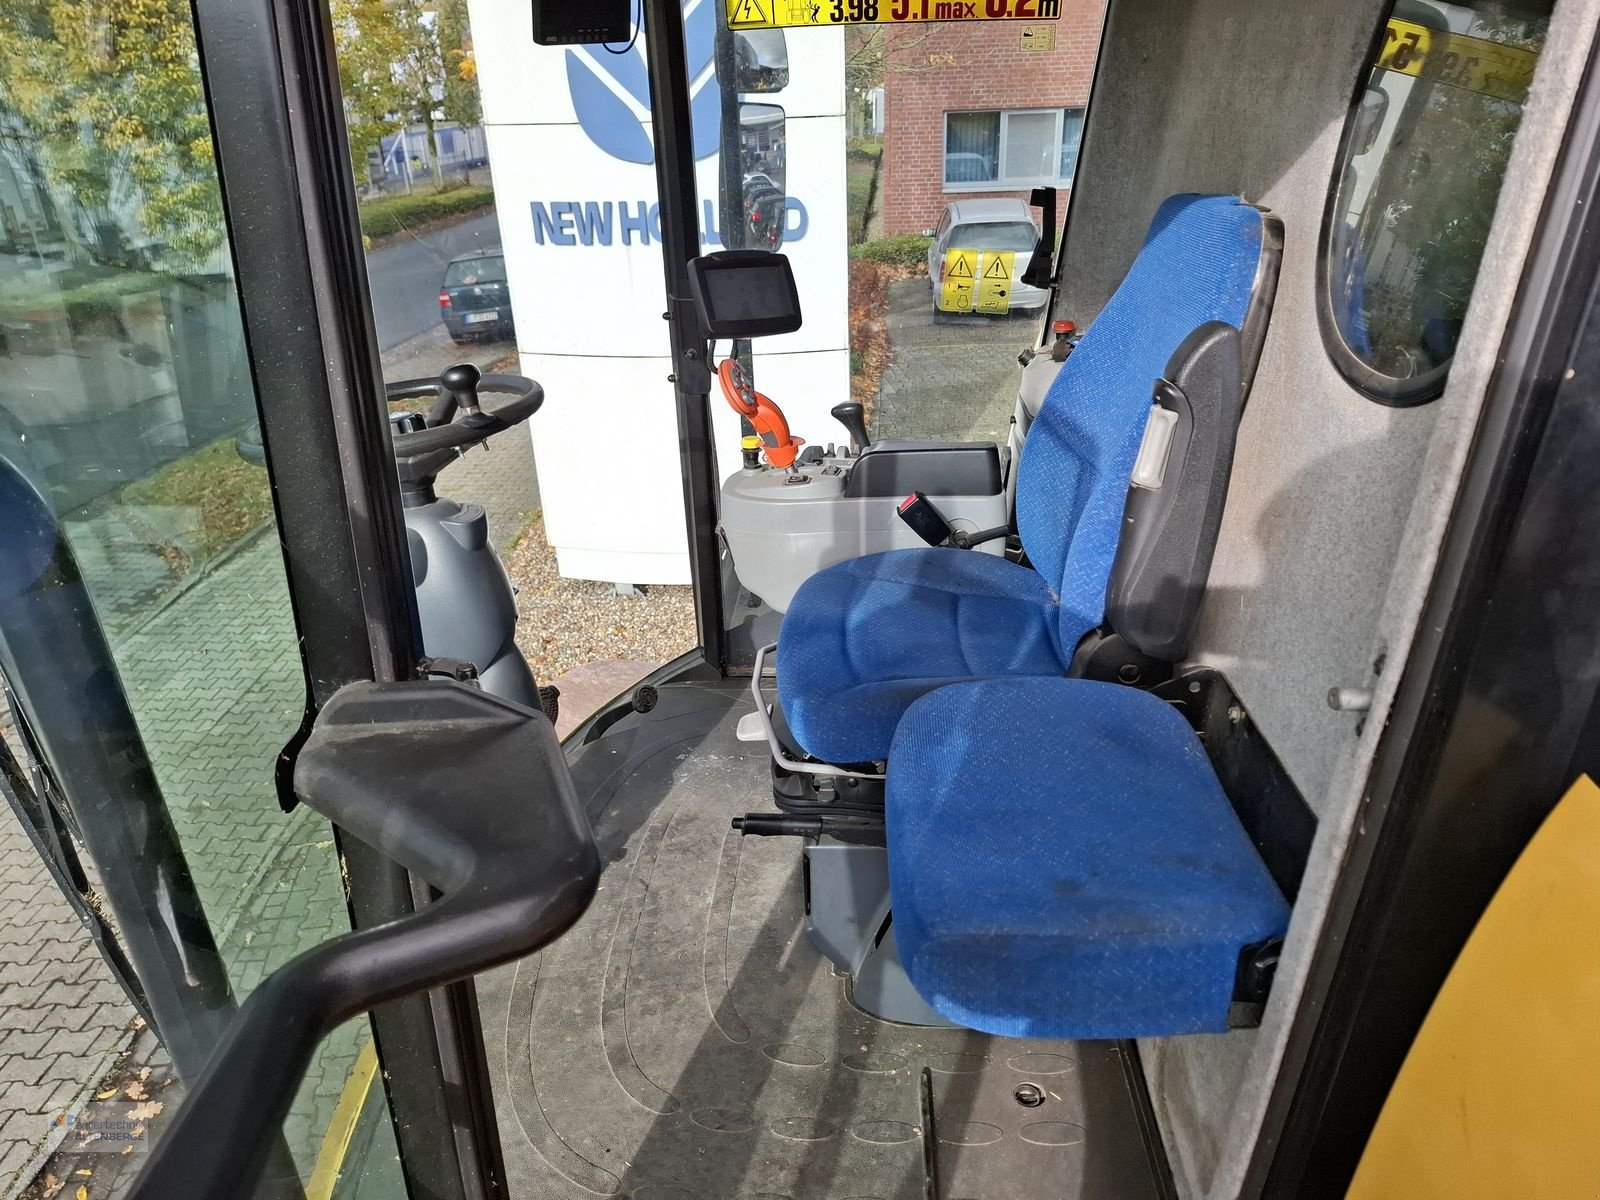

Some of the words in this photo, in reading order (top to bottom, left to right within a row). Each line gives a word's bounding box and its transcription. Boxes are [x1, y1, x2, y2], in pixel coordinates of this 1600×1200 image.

[830, 0, 879, 22] 3.98
[935, 1, 979, 19] max.
[529, 200, 613, 246] NEW
